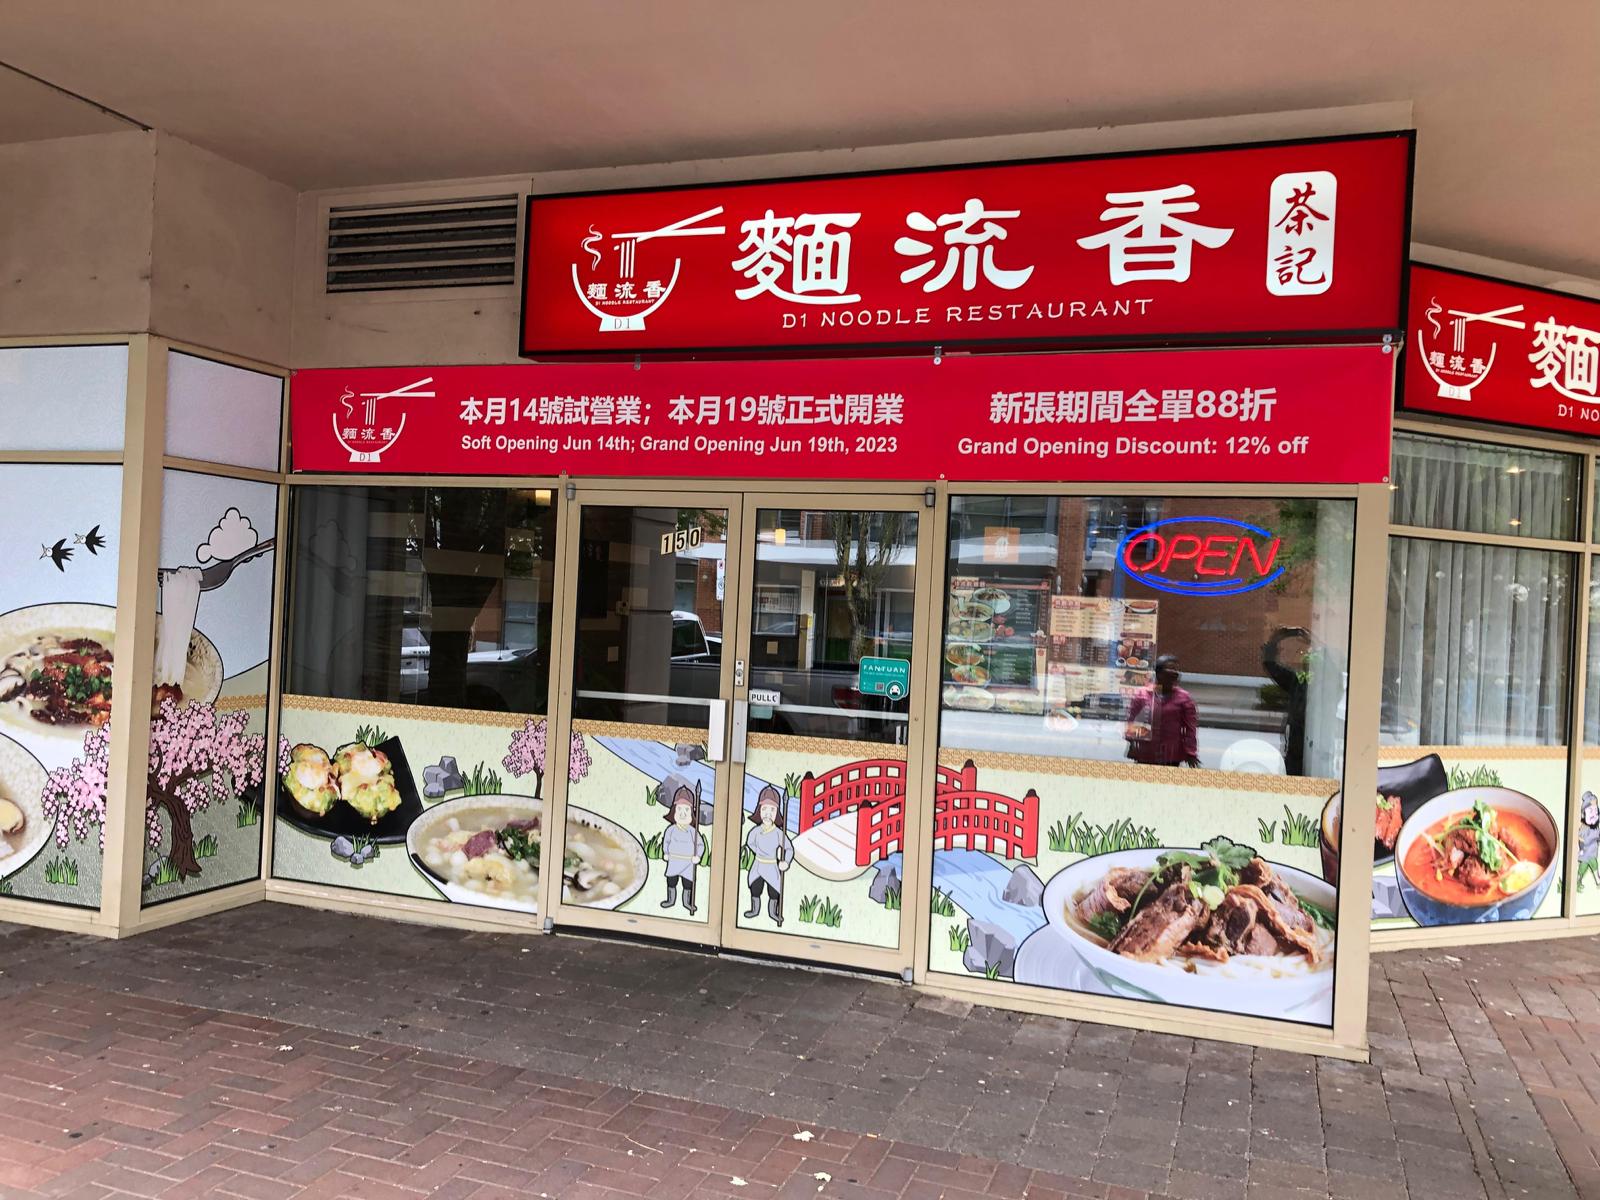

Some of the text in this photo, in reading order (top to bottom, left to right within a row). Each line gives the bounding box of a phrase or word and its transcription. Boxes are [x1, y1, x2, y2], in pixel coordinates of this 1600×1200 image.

[732, 184, 1234, 305] 麵流香
[1274, 182, 1329, 285] 茶記
[614, 318, 630, 329] D1
[783, 298, 1154, 329] D1 NOODLE RESTAURANT
[989, 387, 1278, 425] 新張期間全單88折
[1558, 404, 1573, 418] D1
[461, 435, 898, 455] Soft Opening Jun 14th; Grand Opening Jun 19th, 2023
[957, 436, 1310, 459] Grand Opening Discount: 12% off
[359, 453, 371, 462] D1
[663, 529, 700, 552] 150
[1124, 533, 1281, 576] OPEN
[863, 665, 906, 674] FANTUAN
